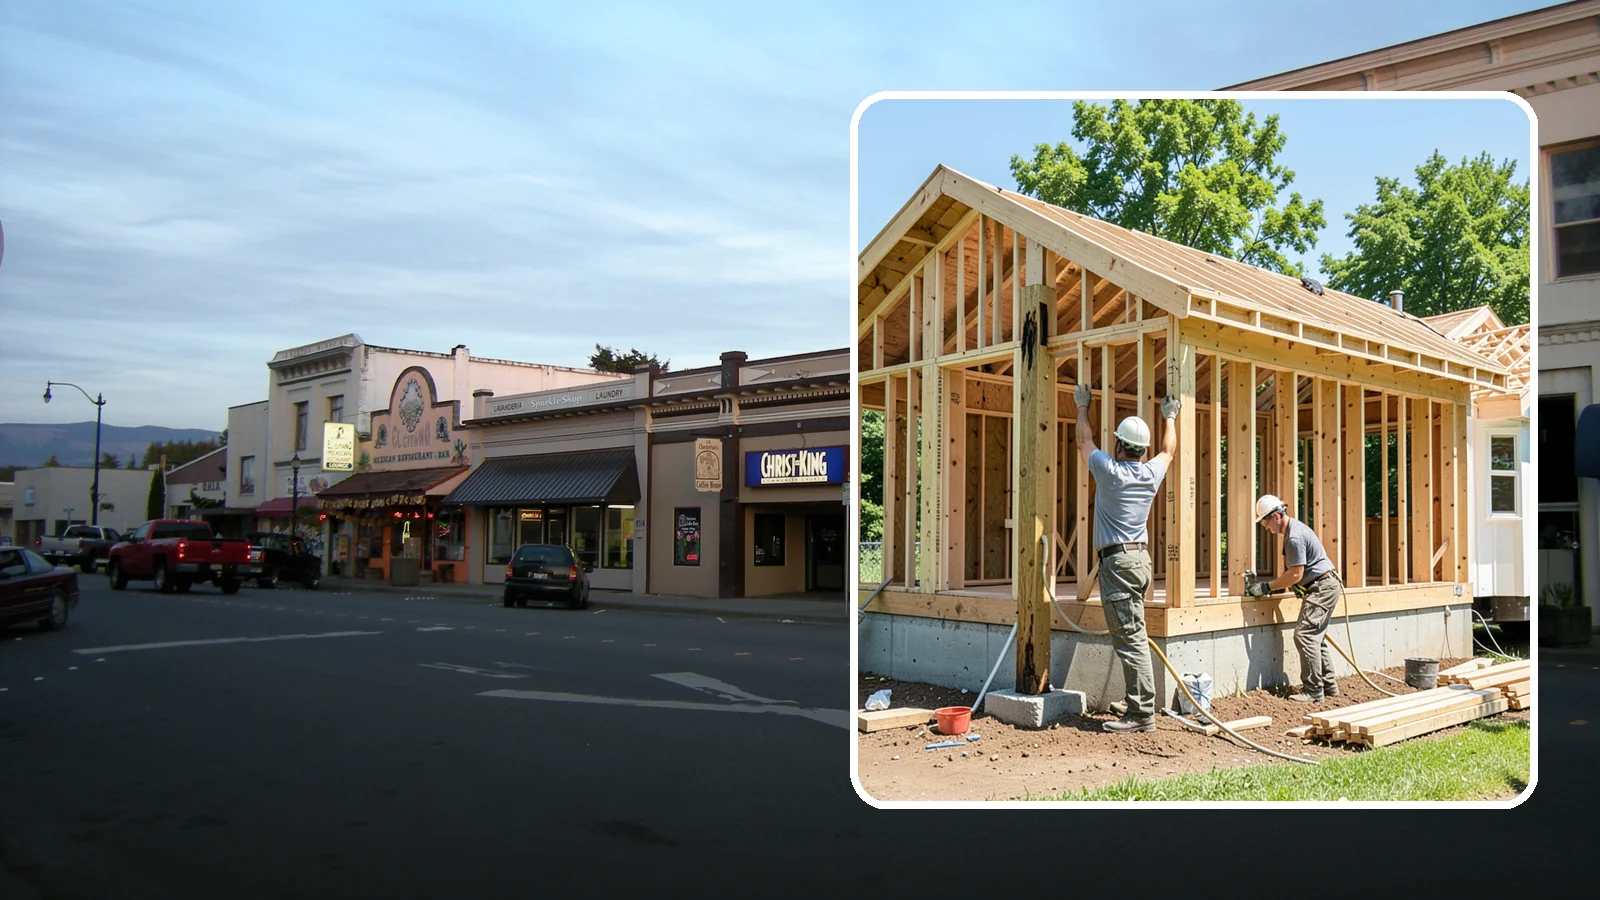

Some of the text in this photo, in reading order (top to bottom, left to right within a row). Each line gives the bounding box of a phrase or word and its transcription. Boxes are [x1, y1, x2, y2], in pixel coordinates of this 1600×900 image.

[531, 394, 583, 408] Sparkle Shop
[595, 389, 623, 400] LAUNDRY
[493, 402, 522, 412] LAVANDERIA
[373, 455, 396, 464] MEXICAN
[397, 451, 433, 462] RESTAURANT
[438, 449, 450, 459] BAR
[760, 450, 827, 478] CHRIST KING
